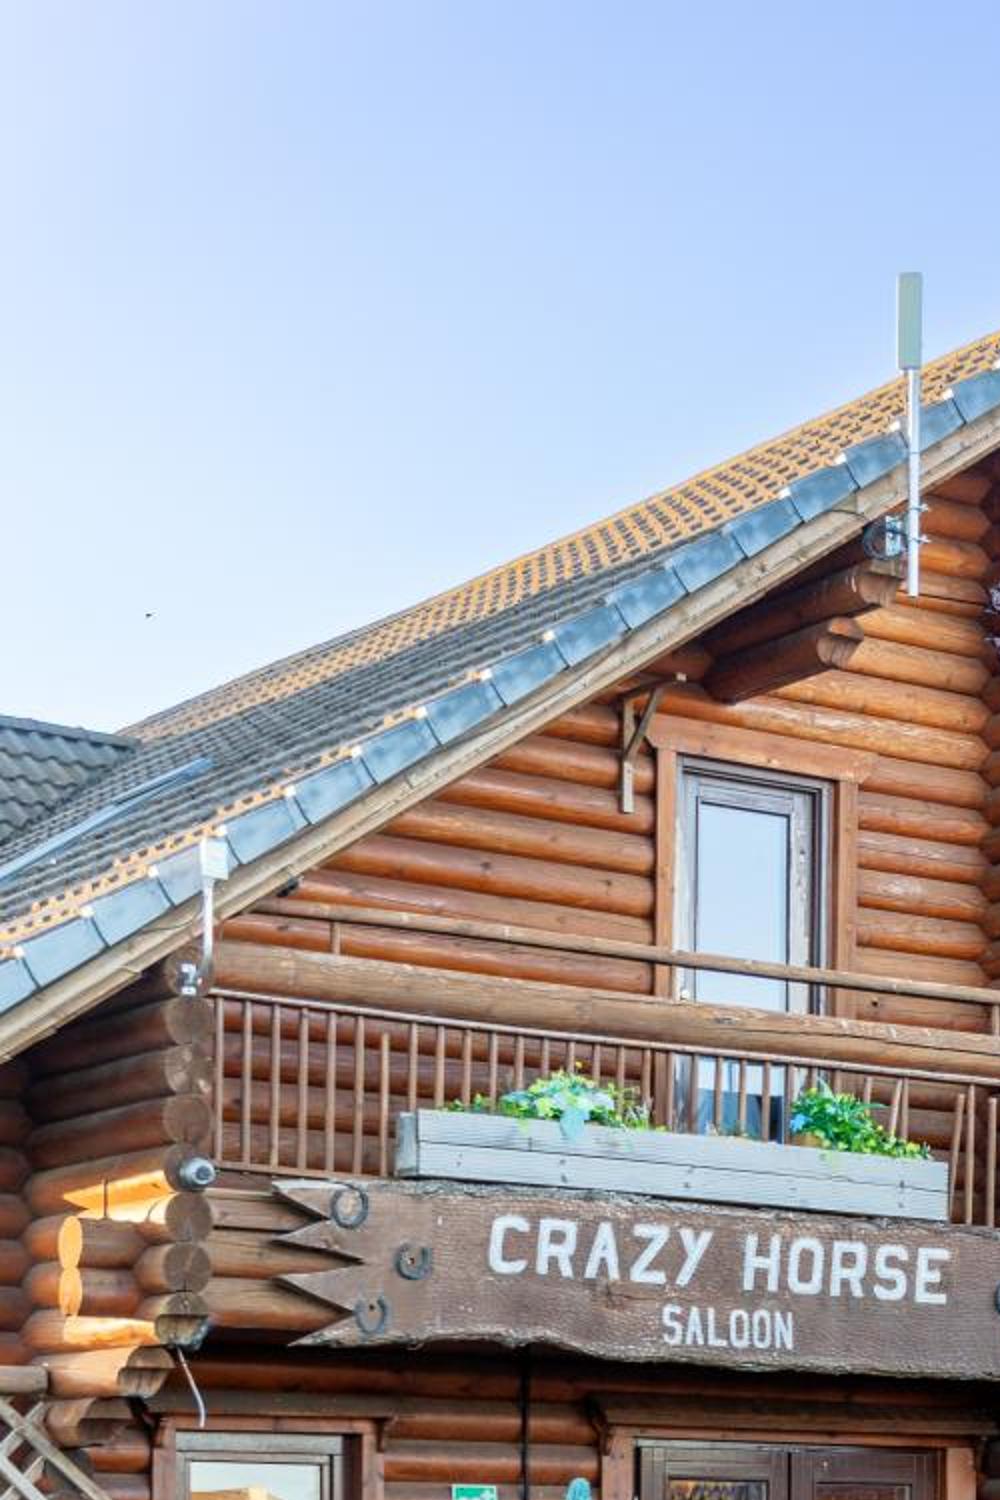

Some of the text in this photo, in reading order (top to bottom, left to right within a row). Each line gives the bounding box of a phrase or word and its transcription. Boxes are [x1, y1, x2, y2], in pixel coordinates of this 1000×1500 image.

[488, 1214, 952, 1306] CRAZY HORSE
[660, 1304, 794, 1350] SALOON
